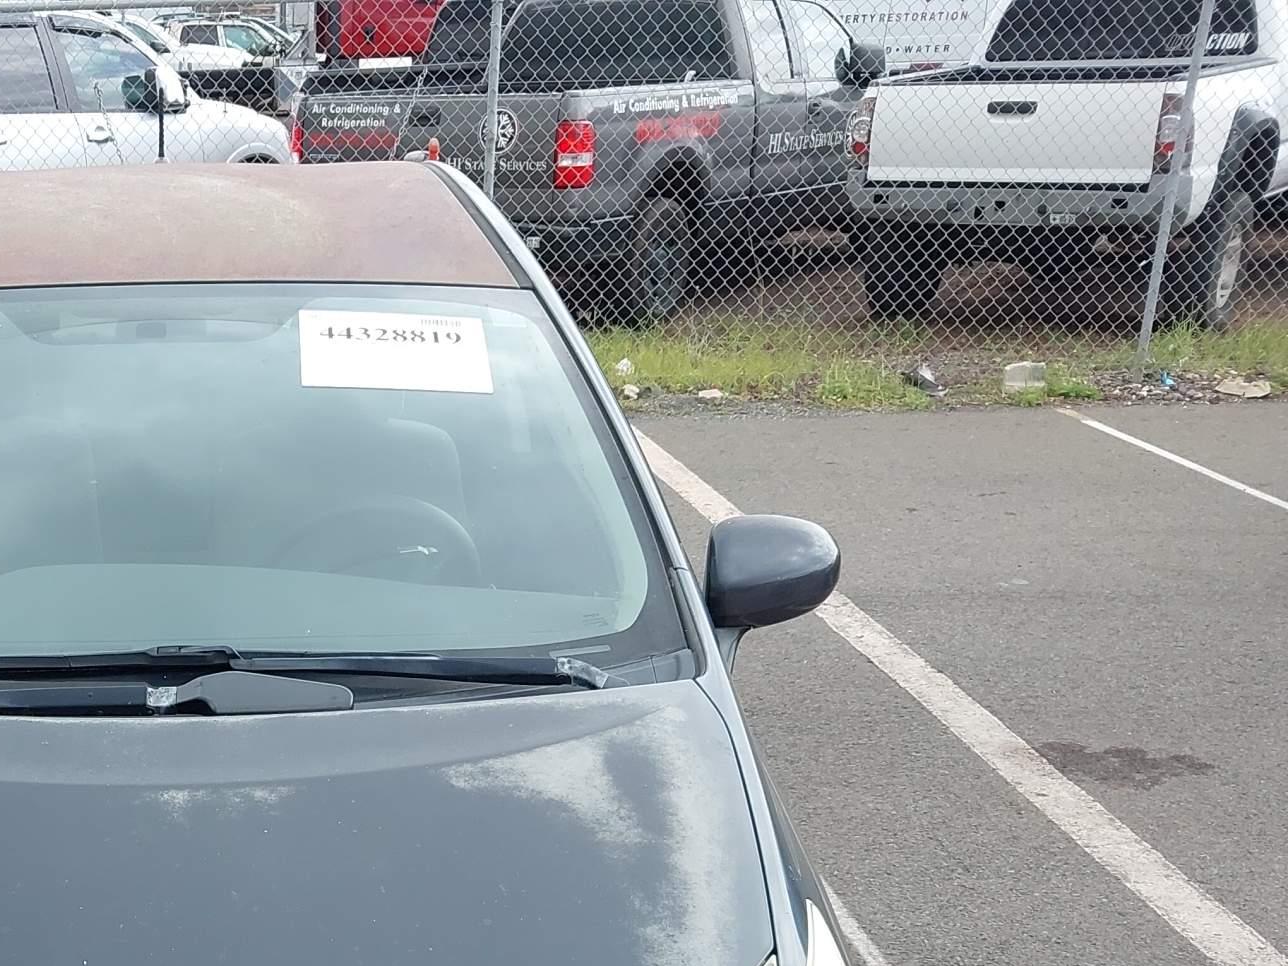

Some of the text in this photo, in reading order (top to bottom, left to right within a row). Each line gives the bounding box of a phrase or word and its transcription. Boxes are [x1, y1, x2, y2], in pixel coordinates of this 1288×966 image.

[879, 11, 969, 23] RESTORATION
[904, 44, 951, 54] WATER
[613, 101, 626, 114] Air
[628, 95, 680, 112] Conditioning
[691, 91, 739, 109] Refrigeration
[312, 103, 401, 116] Air Conditioning &
[321, 118, 386, 129] Refrigeration
[464, 157, 496, 171] STA
[499, 157, 548, 171] SERVICES
[319, 326, 462, 344] 44328819
